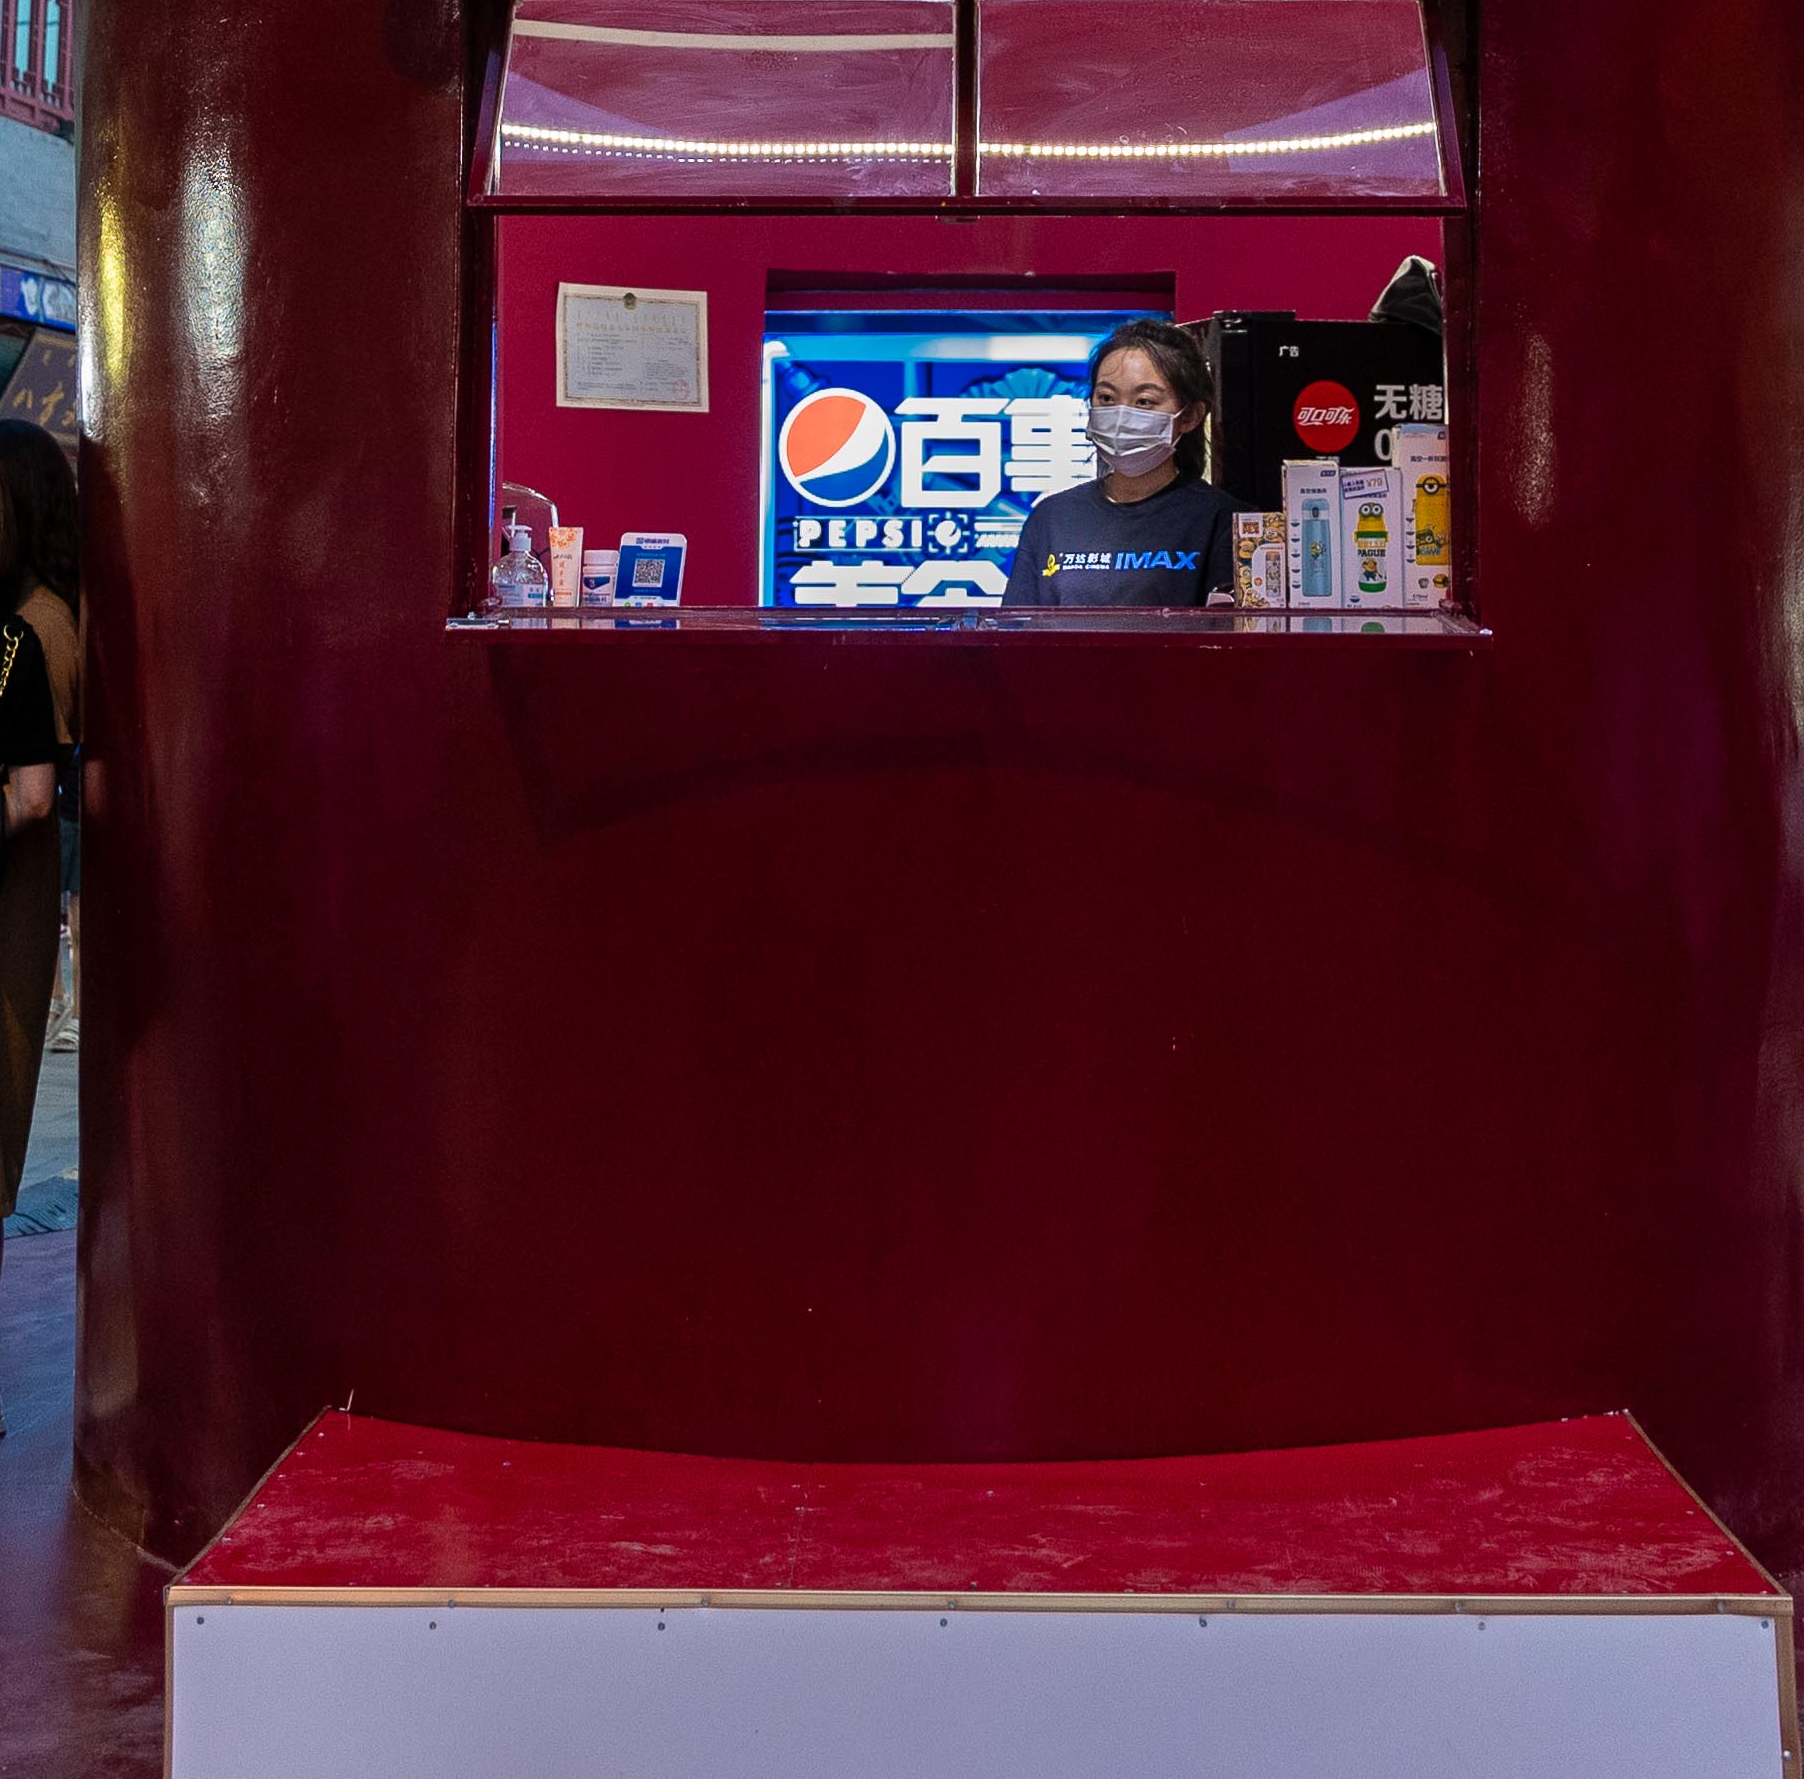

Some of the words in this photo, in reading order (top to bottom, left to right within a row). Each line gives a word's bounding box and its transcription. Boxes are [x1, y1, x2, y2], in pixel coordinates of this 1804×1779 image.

[1279, 345, 1299, 357] 广告
[1373, 383, 1444, 421] 无糖
[1297, 406, 1355, 426] 可口可乐
[798, 518, 923, 549] PEPSI
[1063, 552, 1111, 564] 万达影城
[1114, 550, 1198, 571] IMAX
